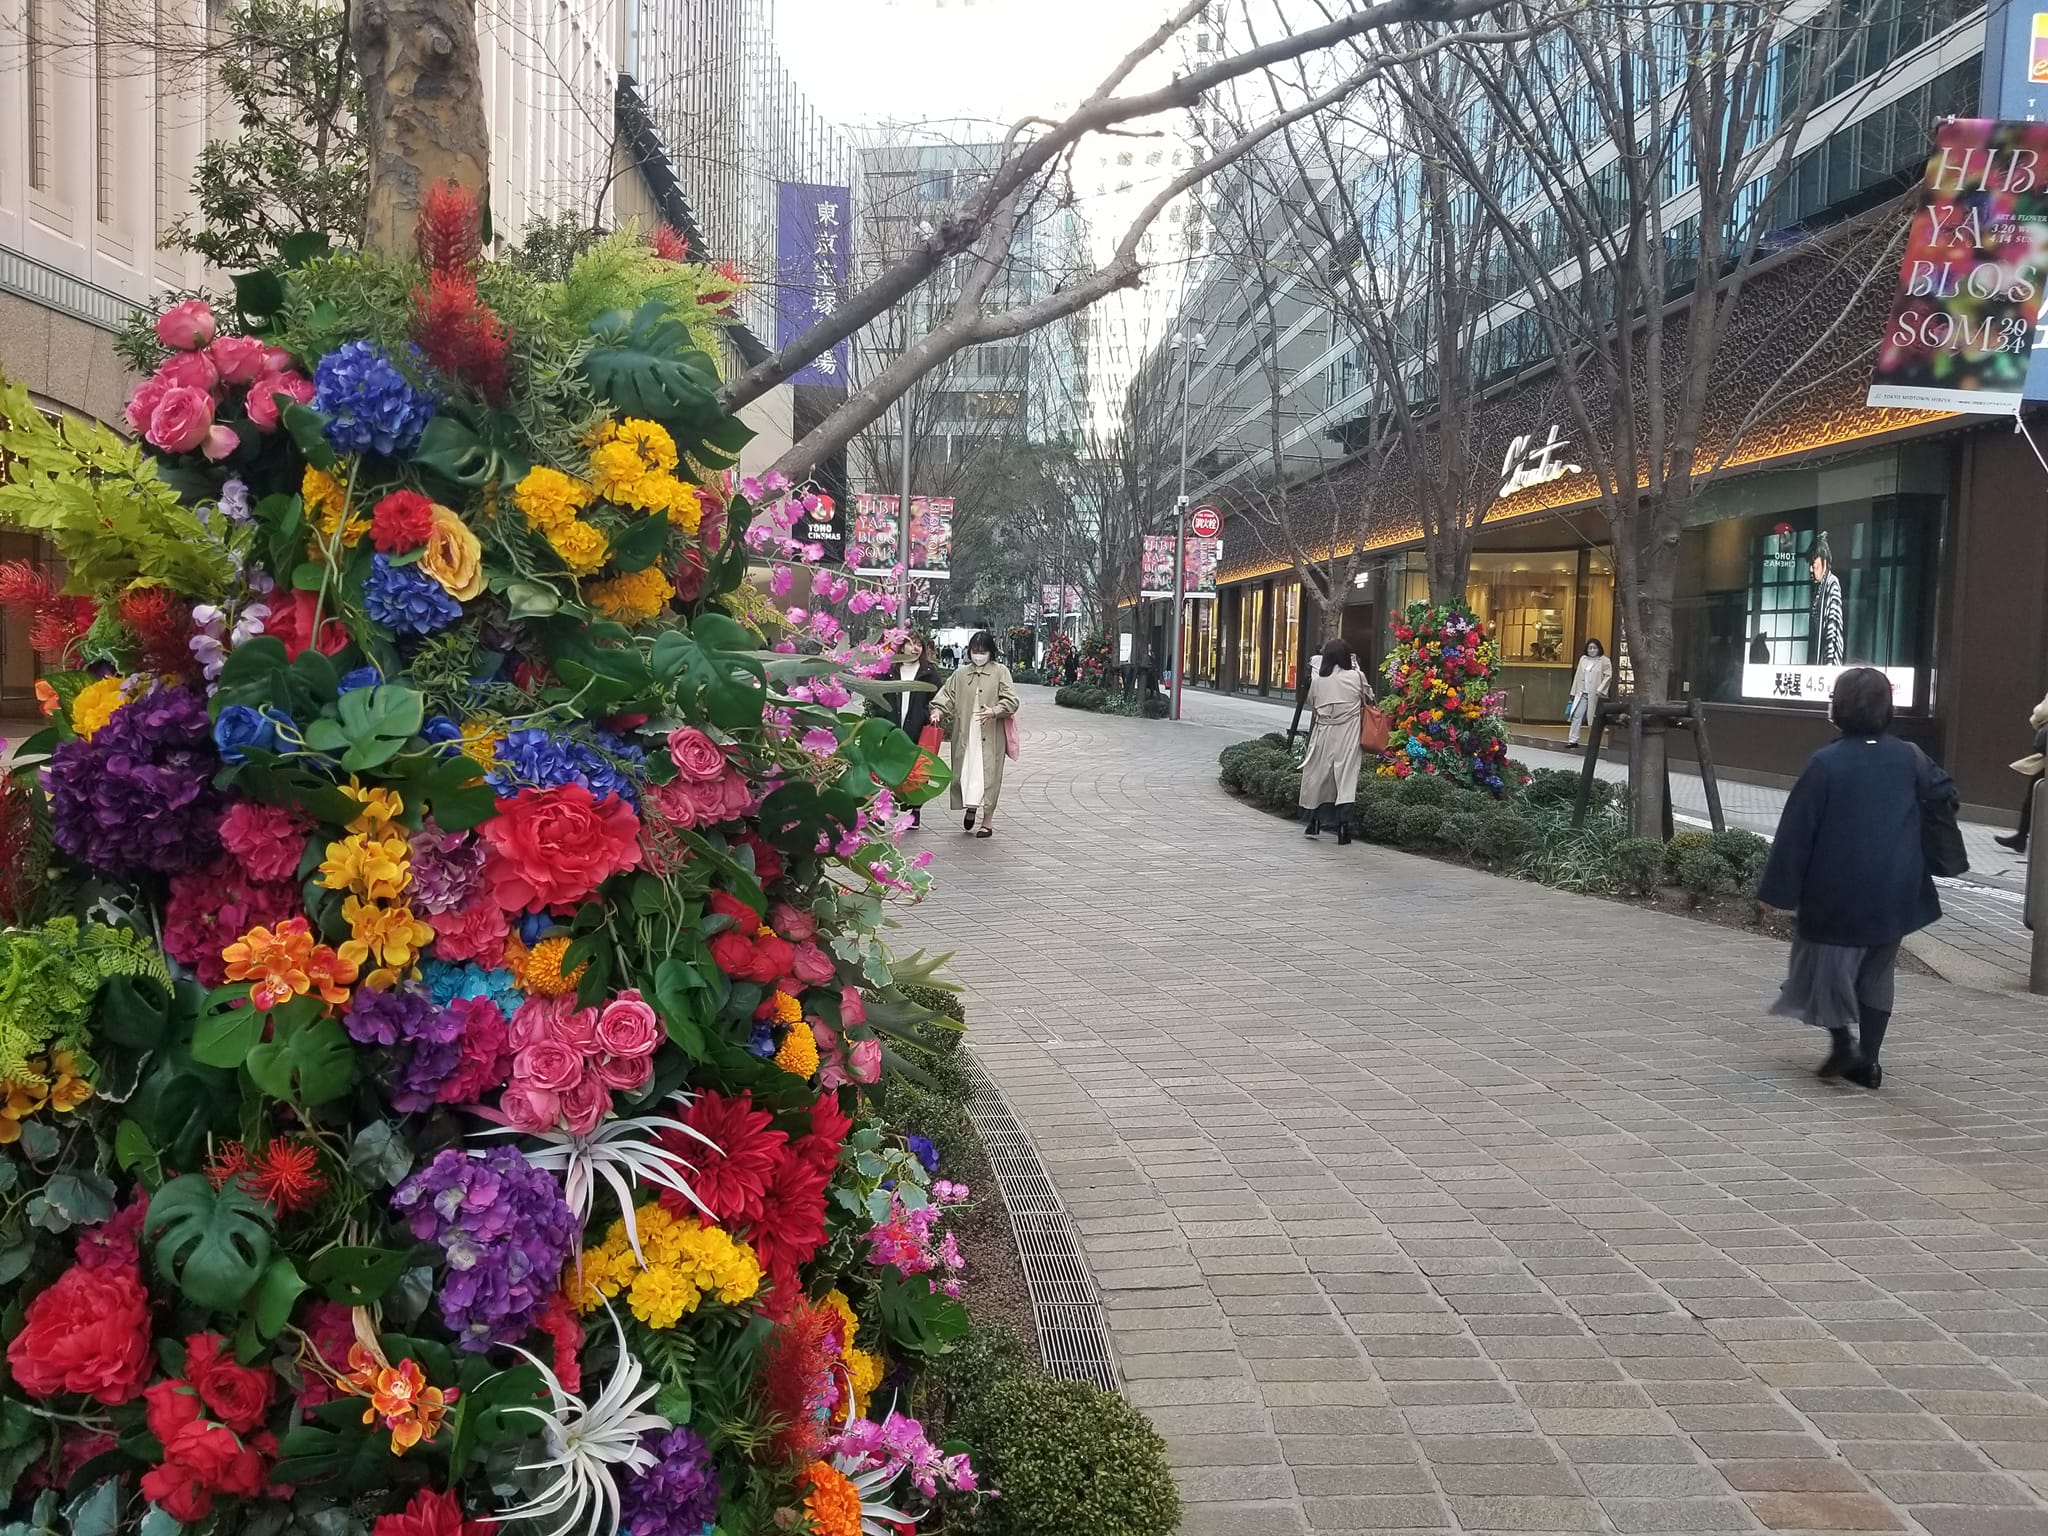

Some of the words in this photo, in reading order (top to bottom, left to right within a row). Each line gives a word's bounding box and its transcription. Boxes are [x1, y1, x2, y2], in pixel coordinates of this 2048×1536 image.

[1930, 146, 2048, 194] HIB
[1926, 205, 1984, 249] YA
[1991, 223, 2016, 234] 3.20
[813, 200, 840, 376] 東京宝塚場
[1905, 260, 2037, 303] BLOS
[1892, 311, 1995, 352] SOM
[808, 523, 832, 532] TOHO
[808, 532, 841, 541] CINEMAS
[1806, 676, 1825, 692] 4.5
